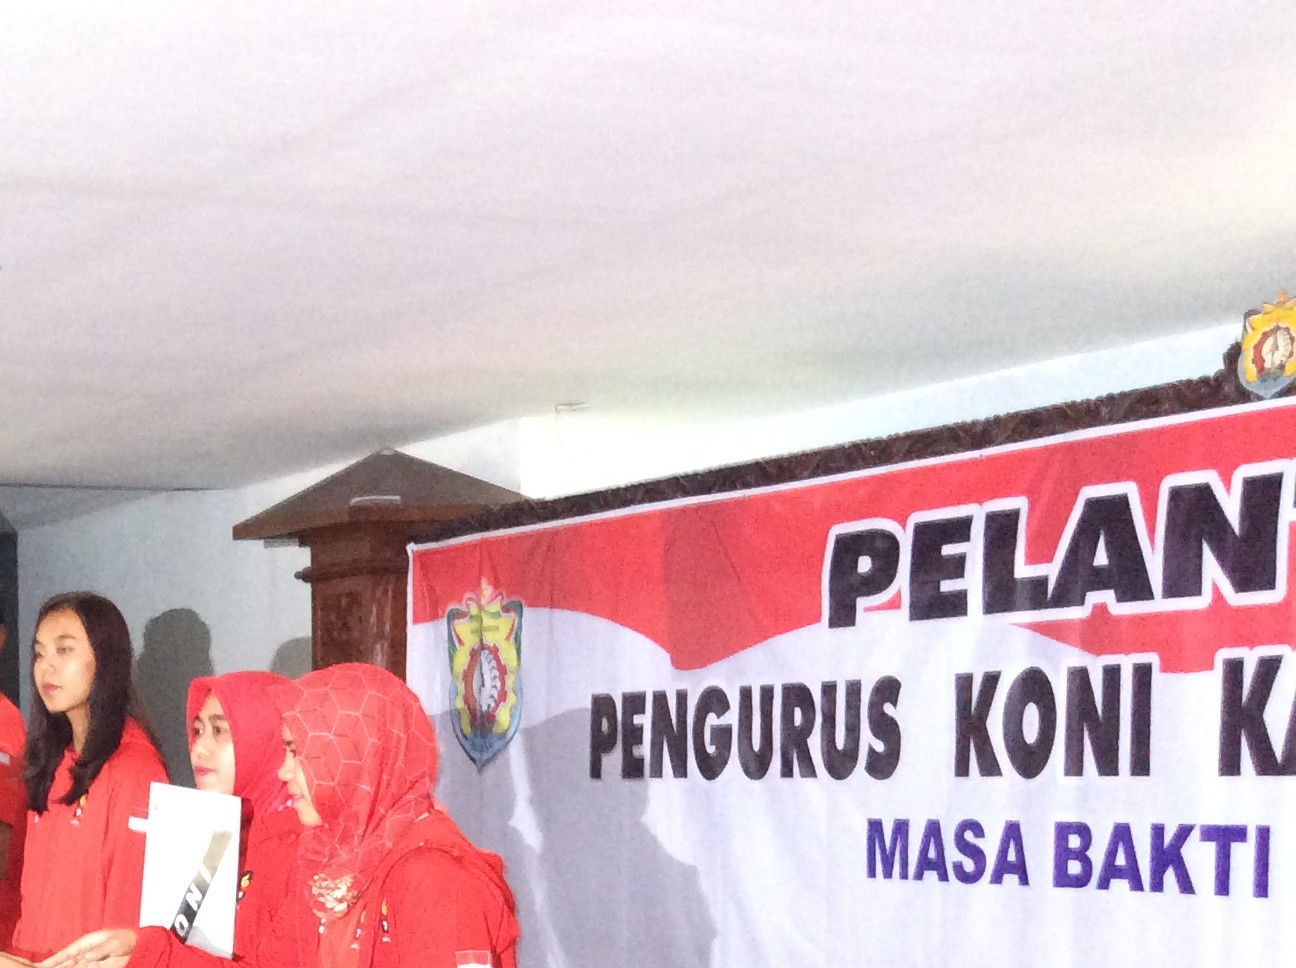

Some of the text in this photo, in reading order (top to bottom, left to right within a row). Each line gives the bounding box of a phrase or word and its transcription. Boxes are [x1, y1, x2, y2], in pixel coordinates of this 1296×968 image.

[827, 472, 1296, 629] PELAN
[589, 676, 901, 781] PENGURUS
[954, 663, 1153, 779] KONI
[867, 819, 1271, 899] MASA BAKTI
